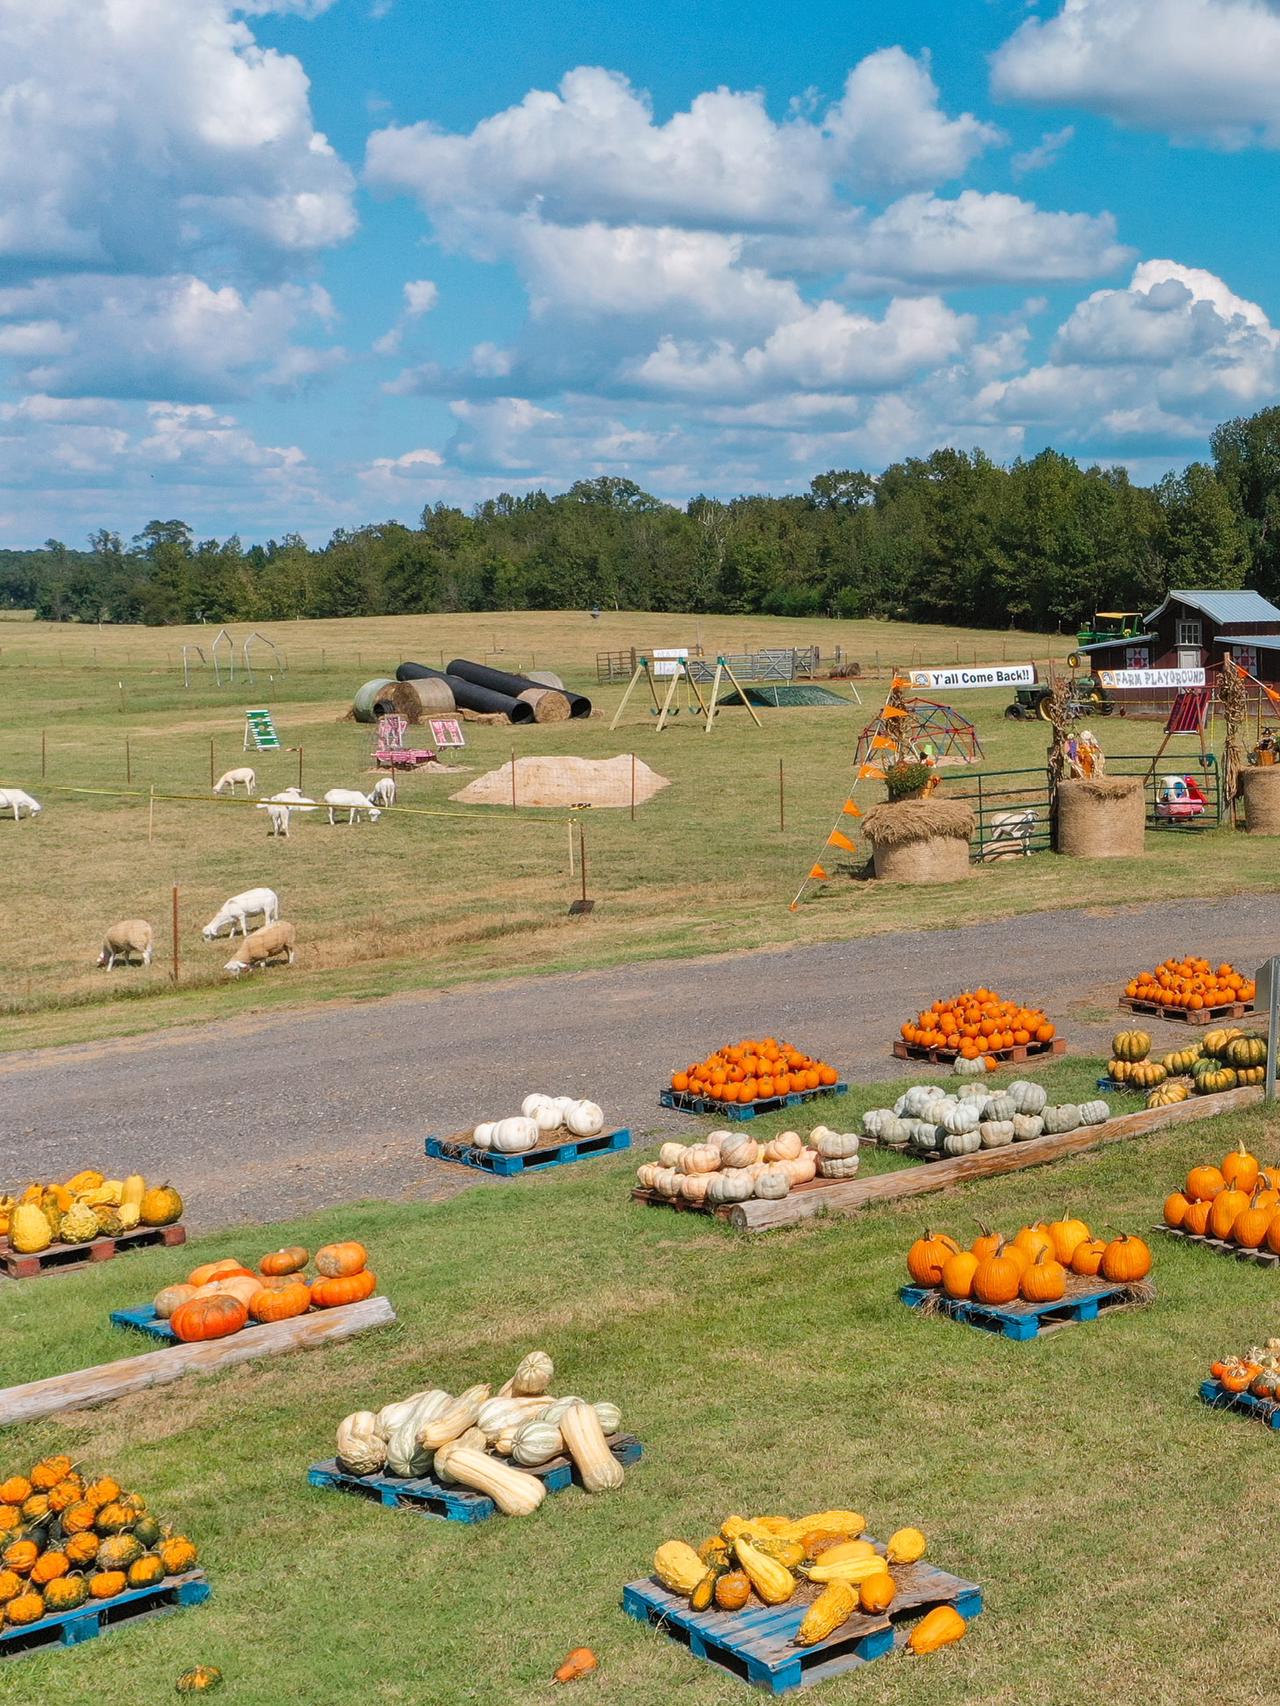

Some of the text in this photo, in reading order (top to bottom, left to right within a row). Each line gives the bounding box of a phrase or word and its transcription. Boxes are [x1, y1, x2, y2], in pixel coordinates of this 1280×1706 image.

[933, 669, 1029, 685] Y'all Come Back!!
[1116, 670, 1204, 687] FARM PLAYGROUND
